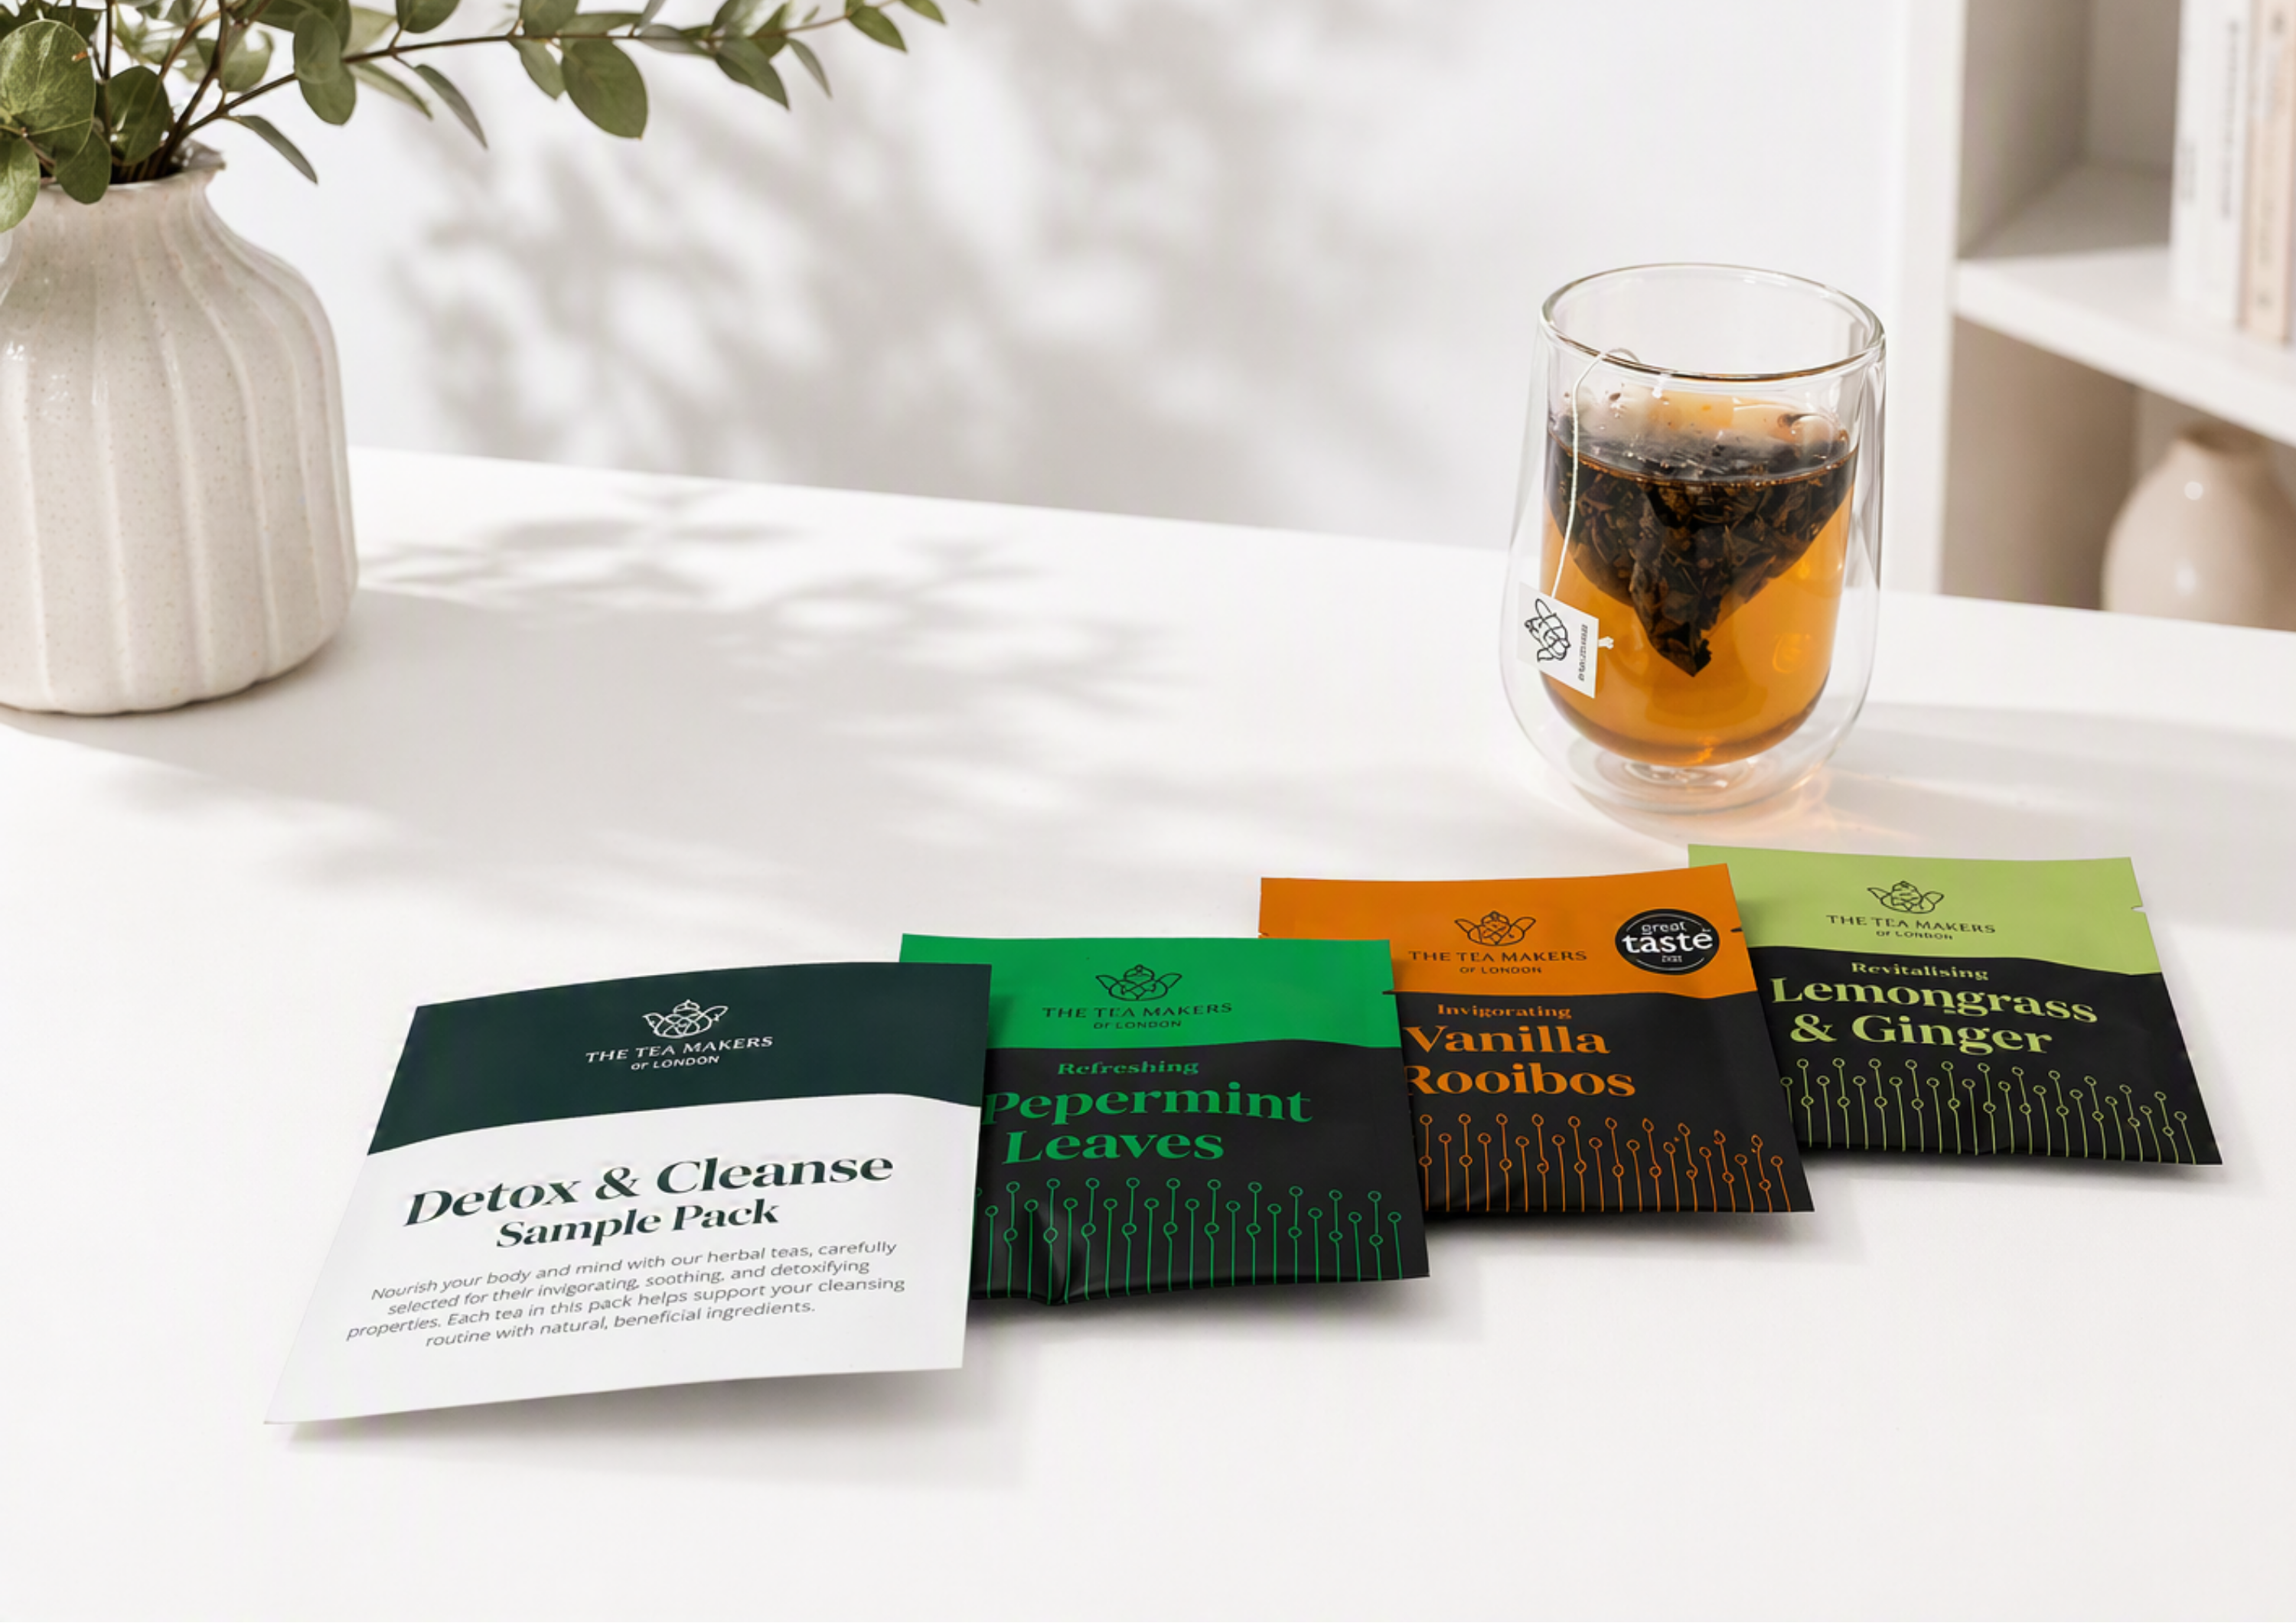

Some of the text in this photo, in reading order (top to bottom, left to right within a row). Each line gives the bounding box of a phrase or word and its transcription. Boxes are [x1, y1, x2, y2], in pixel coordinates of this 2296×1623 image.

[1826, 914, 1996, 934] THE TEA MAKERS
[1408, 950, 1587, 962] THE TEA MAKERS
[1622, 933, 1713, 953] taste
[1851, 962, 1989, 981] Revitalising
[1042, 1002, 1233, 1018] THE TEA MAKERS
[1437, 1003, 1572, 1020] Invigorating
[1769, 976, 2099, 1023] Lemongrass
[1115, 1020, 1182, 1029] LONDON
[1402, 1025, 1611, 1054] Vanilla
[1789, 1013, 2053, 1055] & Ginger
[585, 1036, 774, 1063] THE TEA MAKERS
[653, 1055, 719, 1068] LONDON
[1058, 1061, 1199, 1076] Refreshing
[1404, 1062, 1636, 1097] Rooibos
[981, 1081, 1313, 1126] Pepermint
[1002, 1130, 1225, 1165] Leaves
[405, 1156, 895, 1227] Detox & Cleanse
[496, 1198, 781, 1247] Sample Pack
[371, 1241, 897, 1300] Nourish your body and mind with our herbal teas, carefully
[387, 1260, 869, 1315] selected for their invigorating, soothing, and detoxifying
[346, 1277, 905, 1341] properties. Each tea in this pack helps support your cleansing
[426, 1301, 815, 1347] routine with natural, beneficial ingredients.
